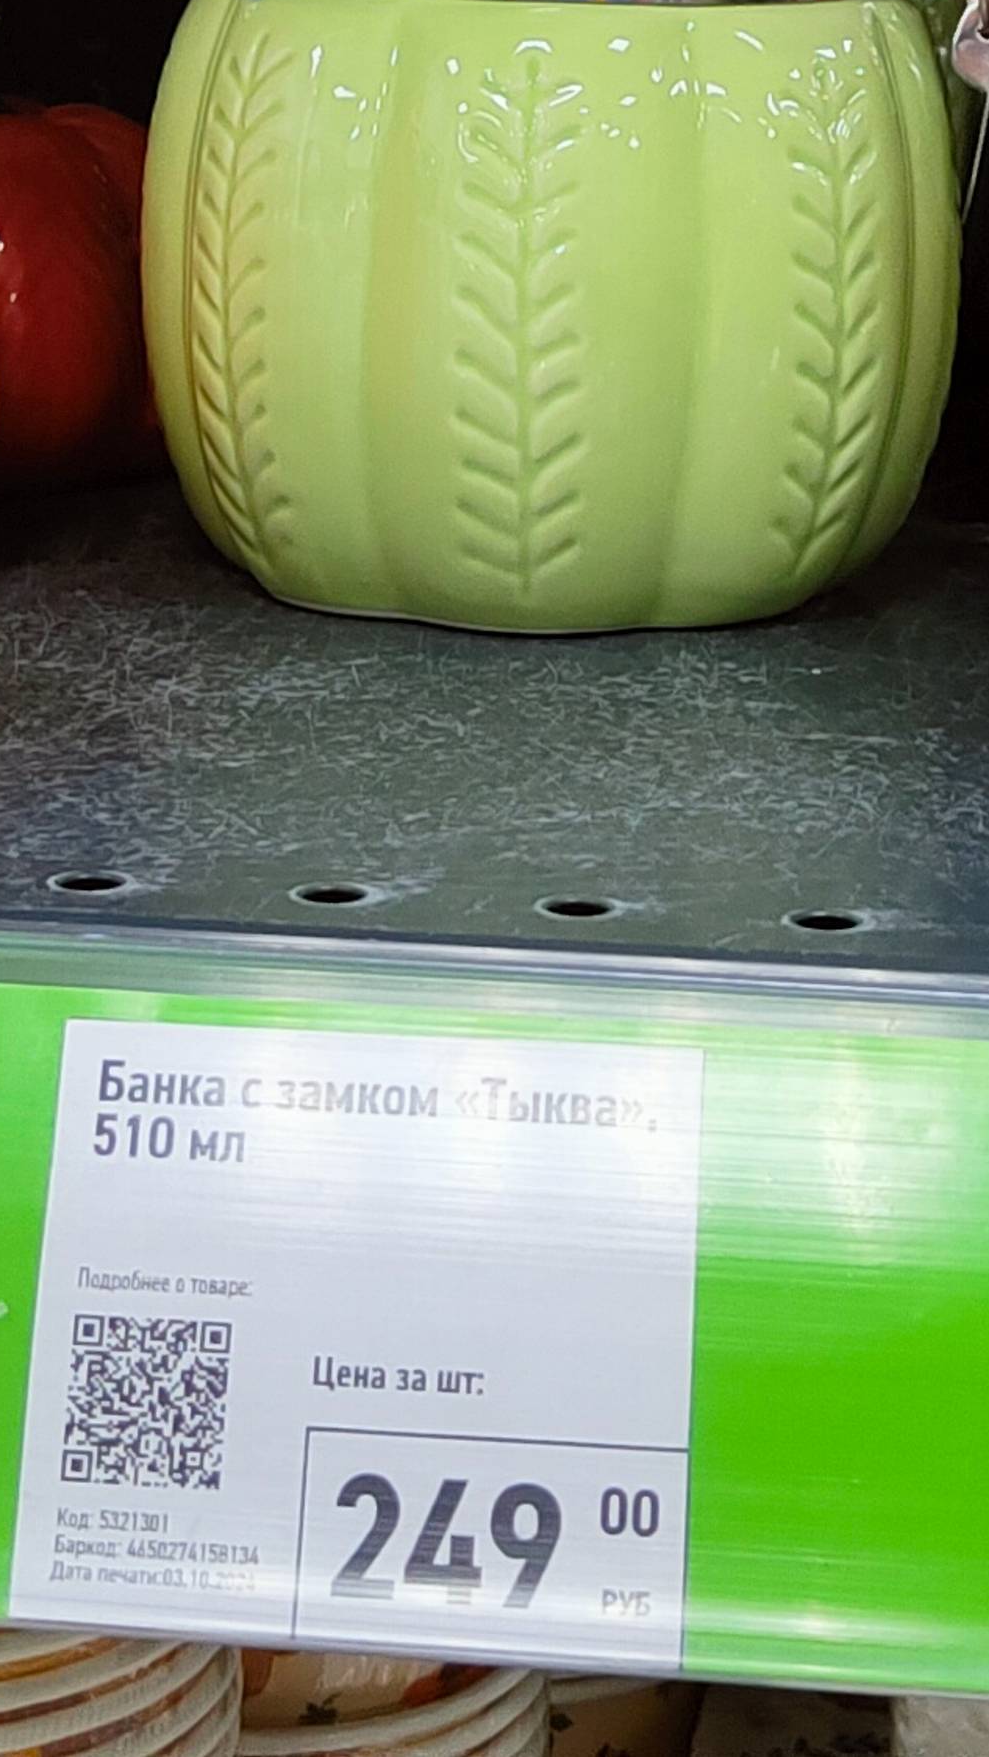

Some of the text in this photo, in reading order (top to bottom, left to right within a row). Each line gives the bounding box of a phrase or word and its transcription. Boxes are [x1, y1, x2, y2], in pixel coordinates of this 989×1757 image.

[99, 1060, 226, 1108] Банка
[241, 1082, 263, 1108] с
[274, 1079, 439, 1116] замком
[93, 1115, 245, 1163] 510 мл
[77, 1267, 252, 1299] Подробнее о товаре:
[313, 1356, 484, 1396] Цена за шт:
[57, 1508, 168, 1533] Код: 5321301
[54, 1534, 259, 1565] Баркод: 4650274158134
[330, 1472, 660, 1609] 249 00
[49, 1560, 92, 1582] Дата
[602, 1588, 651, 1616] РУБ
